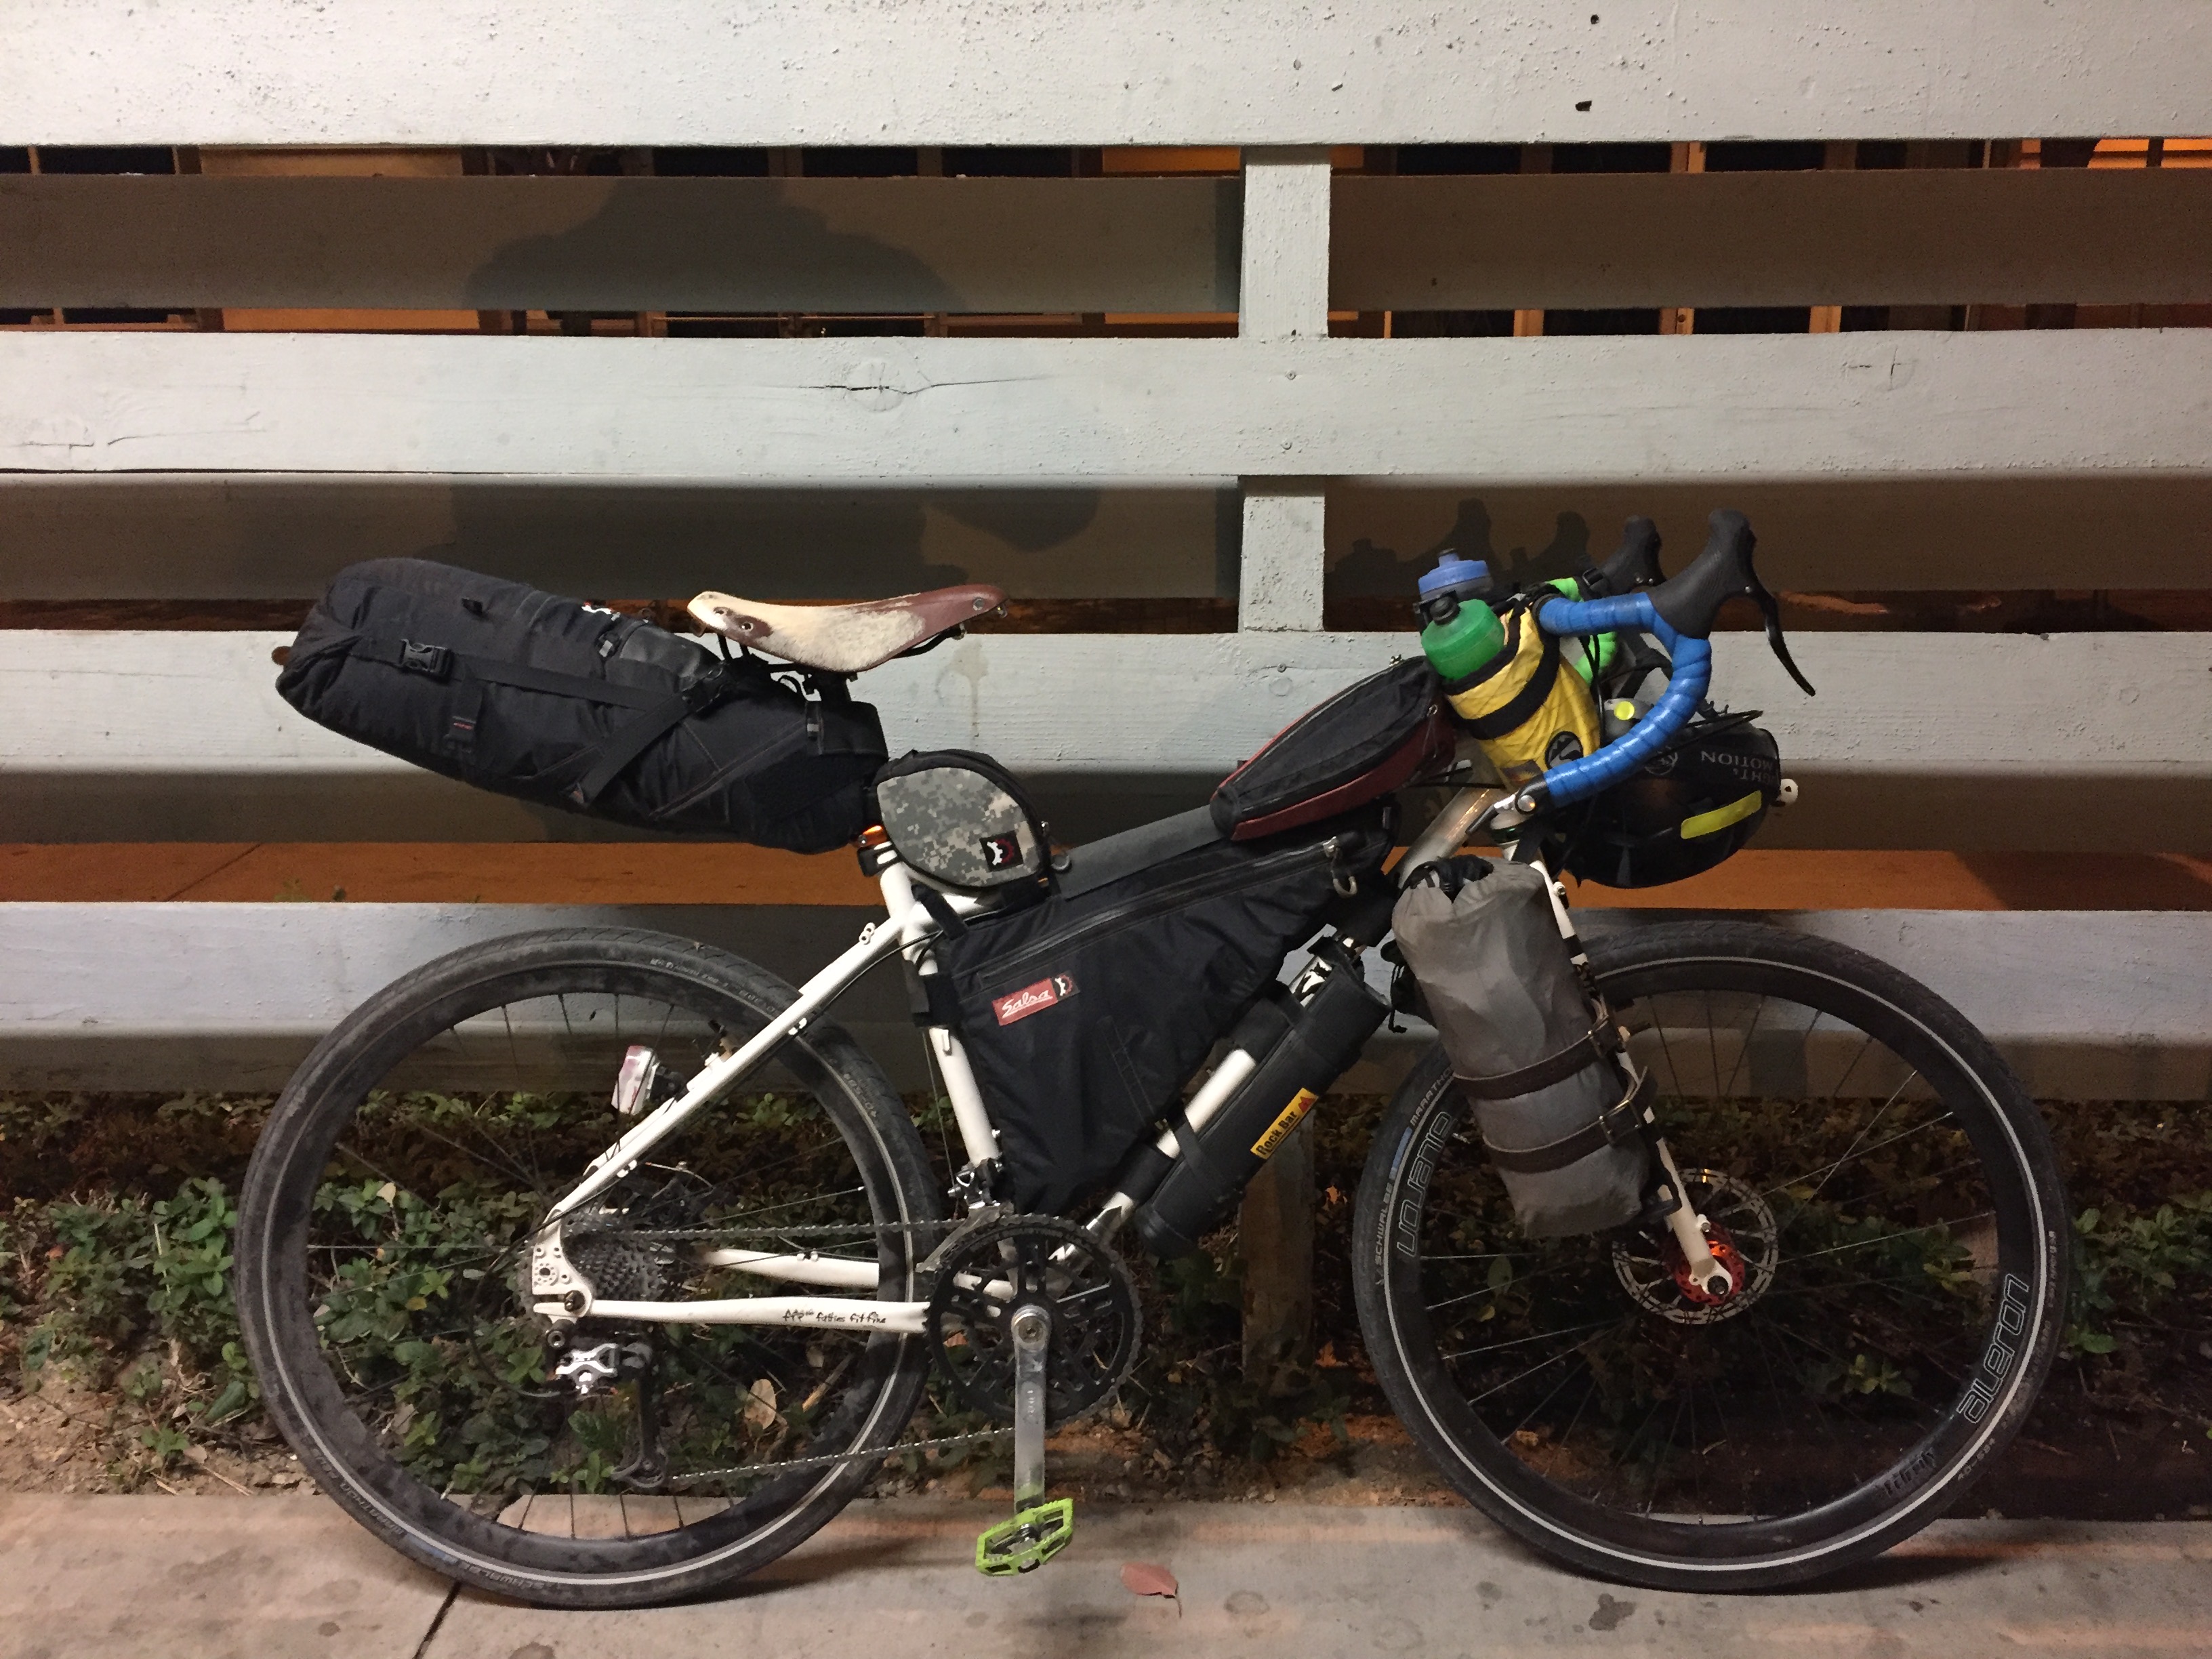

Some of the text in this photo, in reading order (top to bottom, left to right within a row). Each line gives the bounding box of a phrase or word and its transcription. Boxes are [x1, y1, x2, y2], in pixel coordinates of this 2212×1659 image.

[1701, 750, 1772, 771] MOTION
[1002, 990, 1053, 1019] Salsa
[1410, 1067, 1453, 1127] MARATHO
[1256, 1111, 1298, 1155] Rock Bar
[1374, 1182, 1392, 1265] SCHWALBE
